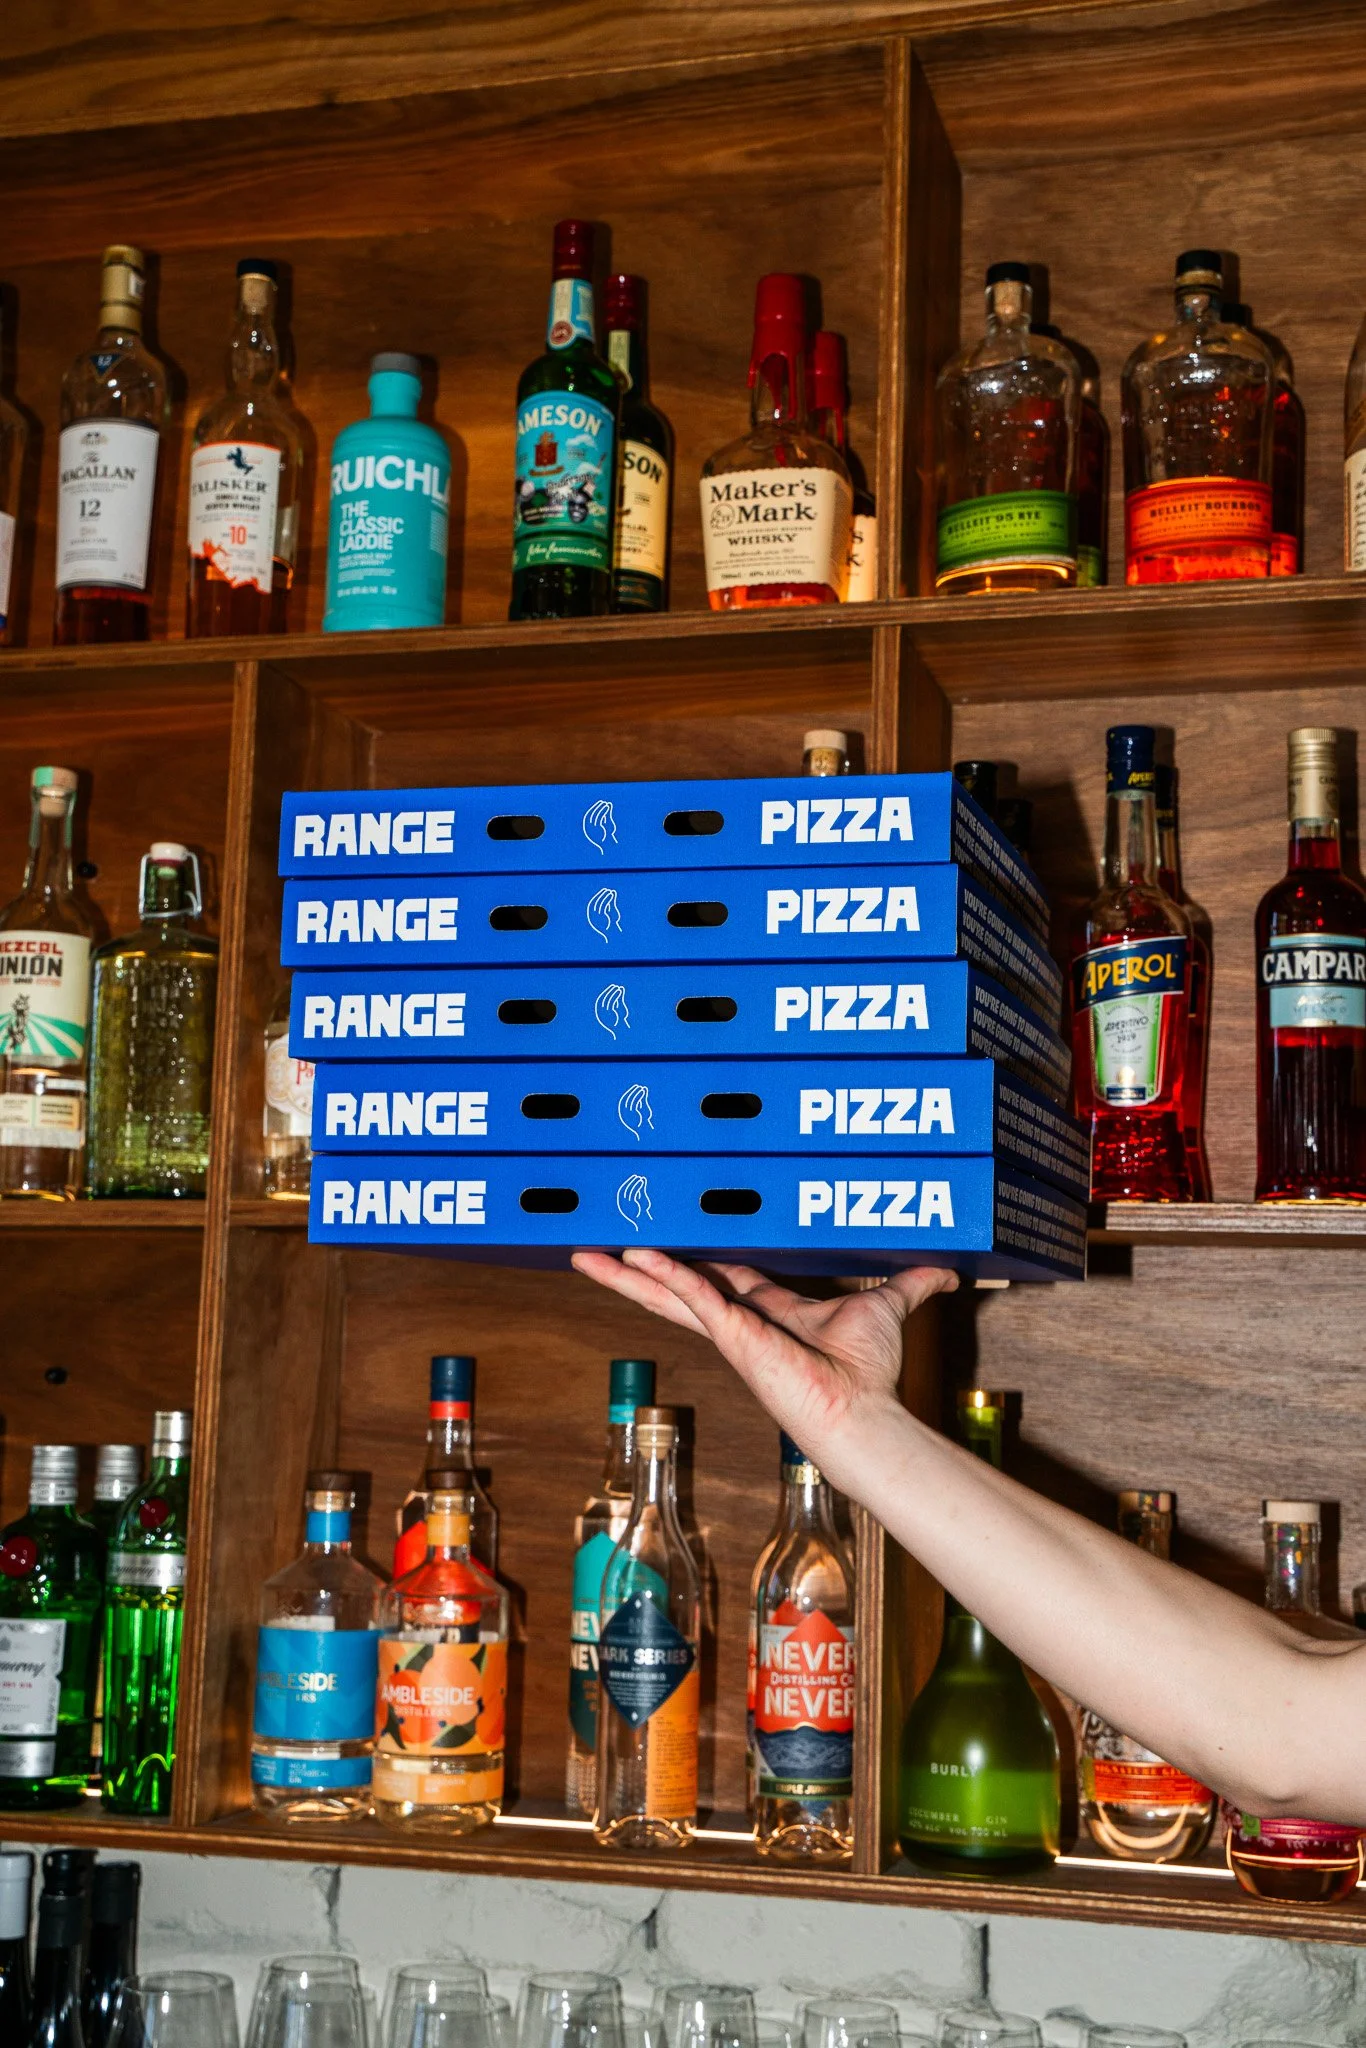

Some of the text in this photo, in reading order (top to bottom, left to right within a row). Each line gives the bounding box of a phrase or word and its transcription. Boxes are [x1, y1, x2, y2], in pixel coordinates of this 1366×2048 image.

[711, 480, 817, 502] Maker's
[80, 499, 101, 517] 12
[341, 500, 369, 520] THE
[736, 503, 815, 525] Mark
[1018, 510, 1041, 520] RYE
[230, 524, 248, 545] 10
[339, 516, 405, 537] CLASSIC
[338, 533, 394, 553] LADDIE
[728, 532, 798, 546] WHISKY
[956, 797, 976, 833] YOU'RE
[294, 800, 913, 857] RANGE PIZZA
[297, 887, 920, 943] RANGE PIZZA
[963, 887, 986, 921] YOU'RE
[962, 908, 984, 943] YOU'RE
[1081, 953, 1177, 999] APEROL
[974, 984, 998, 1015] YOU'RE
[304, 985, 929, 1038] RANGE PIZZA
[972, 1006, 995, 1037] YOU'RE
[1104, 1016, 1149, 1032] APERITIVO
[999, 1082, 1019, 1108] YOU'RE
[326, 1088, 955, 1136] RANGE PIZZA
[998, 1104, 1017, 1130] YOU'RE
[997, 1127, 1016, 1152] YOU'RE
[998, 1180, 1018, 1202] YOU'RE
[323, 1181, 954, 1227] RANGE PIZZA
[997, 1202, 1016, 1224] YOU'RE
[996, 1224, 1014, 1245] YOU'RE
[634, 1647, 688, 1666] SERIES
[770, 1671, 837, 1687] DISTILLING
[382, 1686, 475, 1706] AMBLESIDE
[985, 1816, 1008, 1824] GIN
